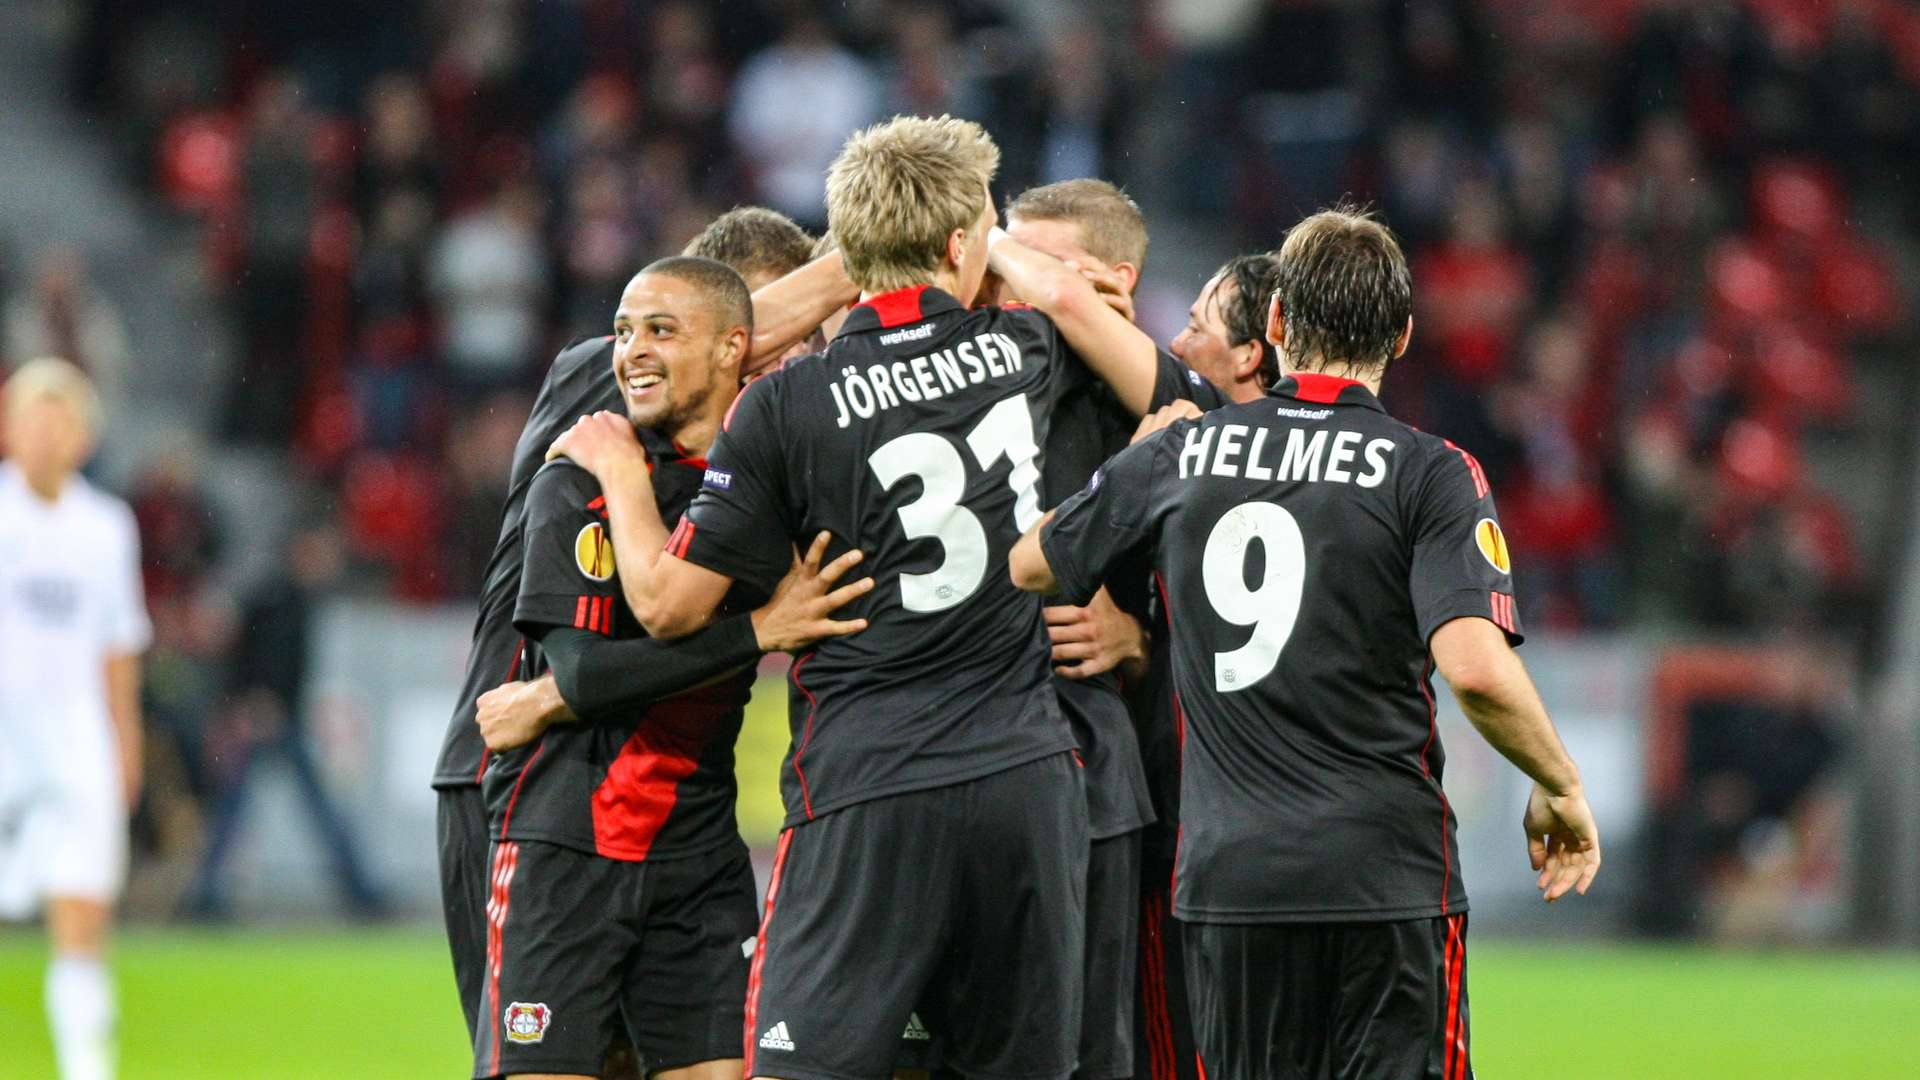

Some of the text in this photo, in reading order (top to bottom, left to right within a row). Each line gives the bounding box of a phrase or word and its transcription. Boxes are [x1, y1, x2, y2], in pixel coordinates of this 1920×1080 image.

[829, 333, 1024, 428] JÖRGENSEN
[1277, 407, 1330, 420] werkself
[1178, 424, 1397, 489] HELMES
[867, 392, 1046, 614] 31
[1202, 501, 1307, 693] 9
[759, 1037, 795, 1052] adidas
